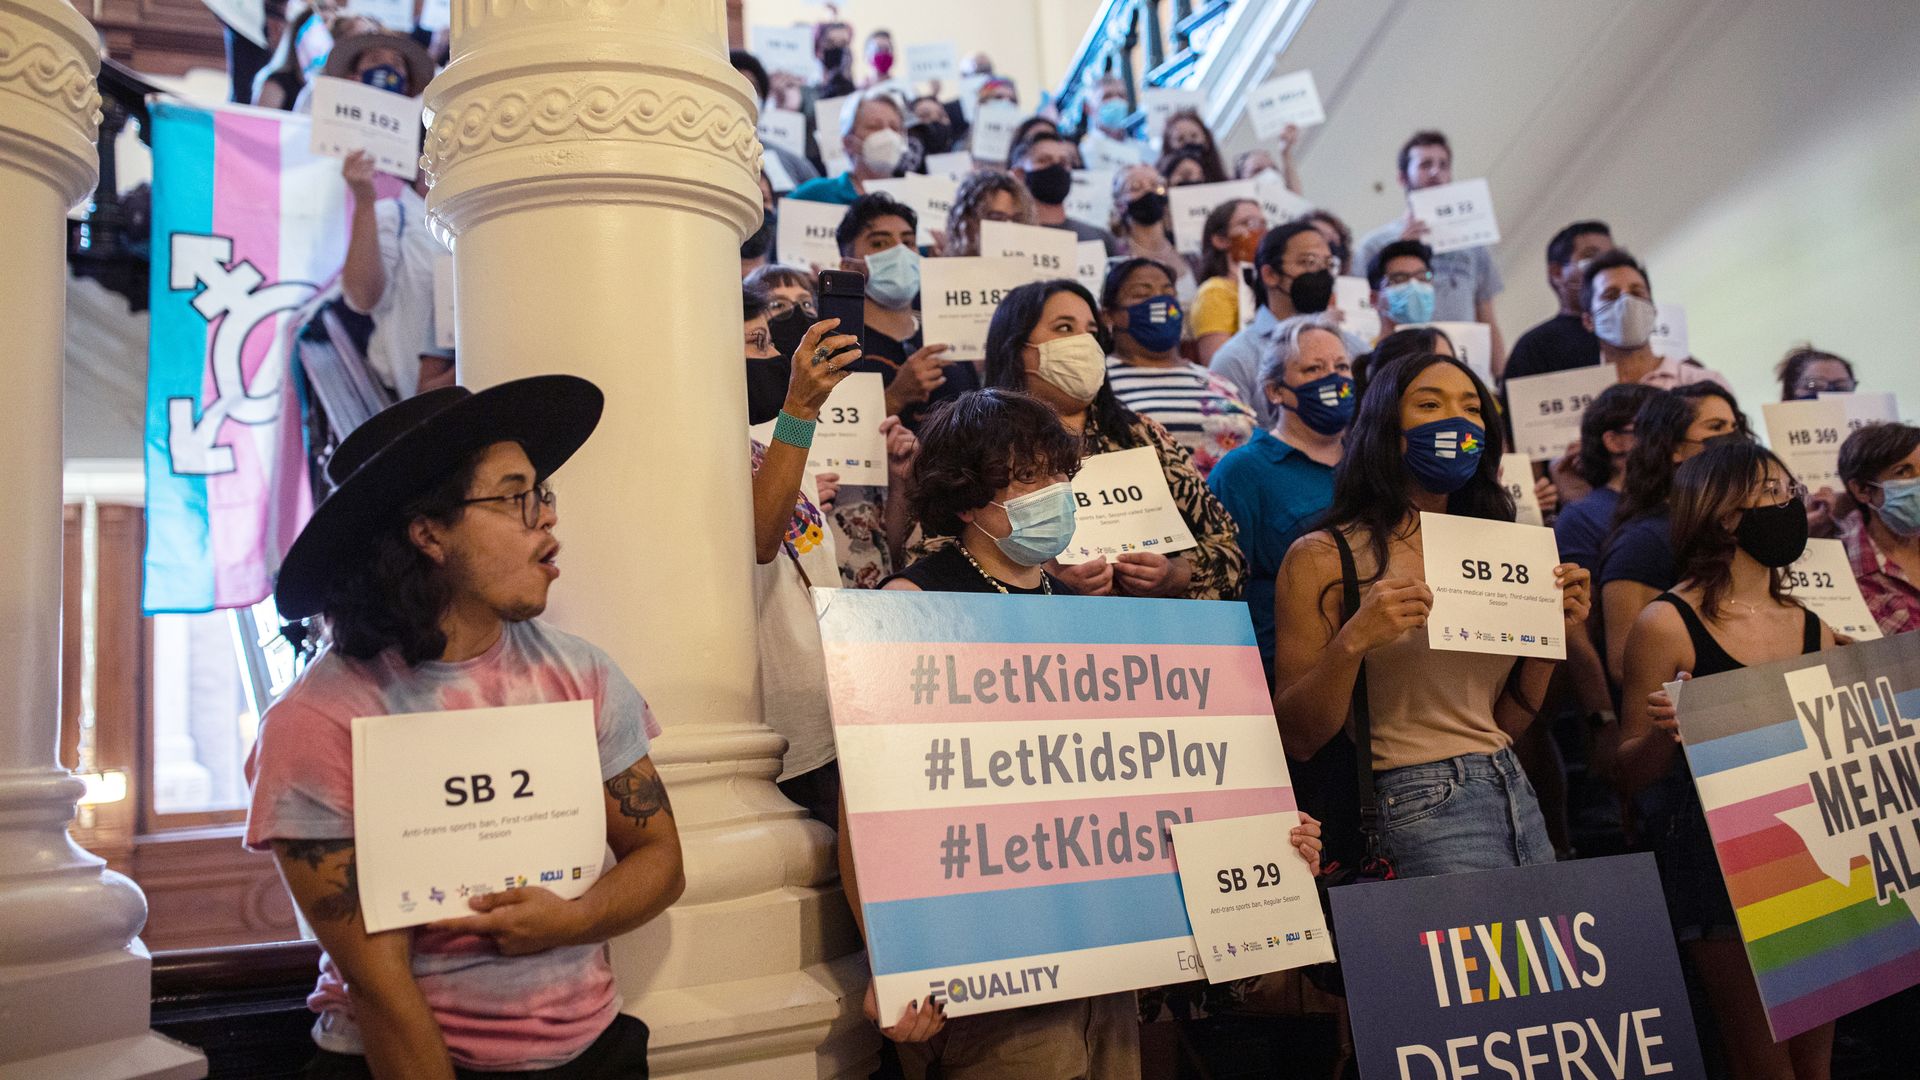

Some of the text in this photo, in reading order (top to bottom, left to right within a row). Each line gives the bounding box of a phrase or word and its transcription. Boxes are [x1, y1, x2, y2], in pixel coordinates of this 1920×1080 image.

[1032, 253, 1061, 270] 185
[945, 291, 972, 306] HB
[831, 407, 860, 424] 33
[1539, 399, 1564, 416] SB
[1788, 427, 1839, 446] HB 369
[1074, 485, 1143, 508] B 100
[1461, 558, 1530, 585] SB 28
[1790, 570, 1835, 588] SB 32
[1436, 586, 1463, 595] Anti-trans
[1463, 588, 1483, 597] medical
[909, 653, 1212, 710] #LetKidsPlay
[1797, 681, 1916, 760] Y'ALL
[924, 729, 1229, 792] #LetKidsPlay
[444, 769, 534, 807] SB 2
[402, 807, 580, 838] Anti-trans sports ban, First-called Special
[478, 829, 512, 841] Session
[1868, 817, 1920, 901] AL
[540, 869, 563, 883] ACLU
[1217, 862, 1281, 894] SB 29
[1210, 905, 1235, 915] Anti-trans
[1236, 902, 1251, 912] sports
[1263, 897, 1282, 906] Regular
[1283, 895, 1301, 903] Session
[1286, 931, 1300, 942] ACLU
[1177, 950, 1205, 973] Equ
[1419, 911, 1607, 1008] TEXANS
[929, 965, 1060, 1005] EQUALITY
[1396, 1007, 1674, 1080] DESERVE
